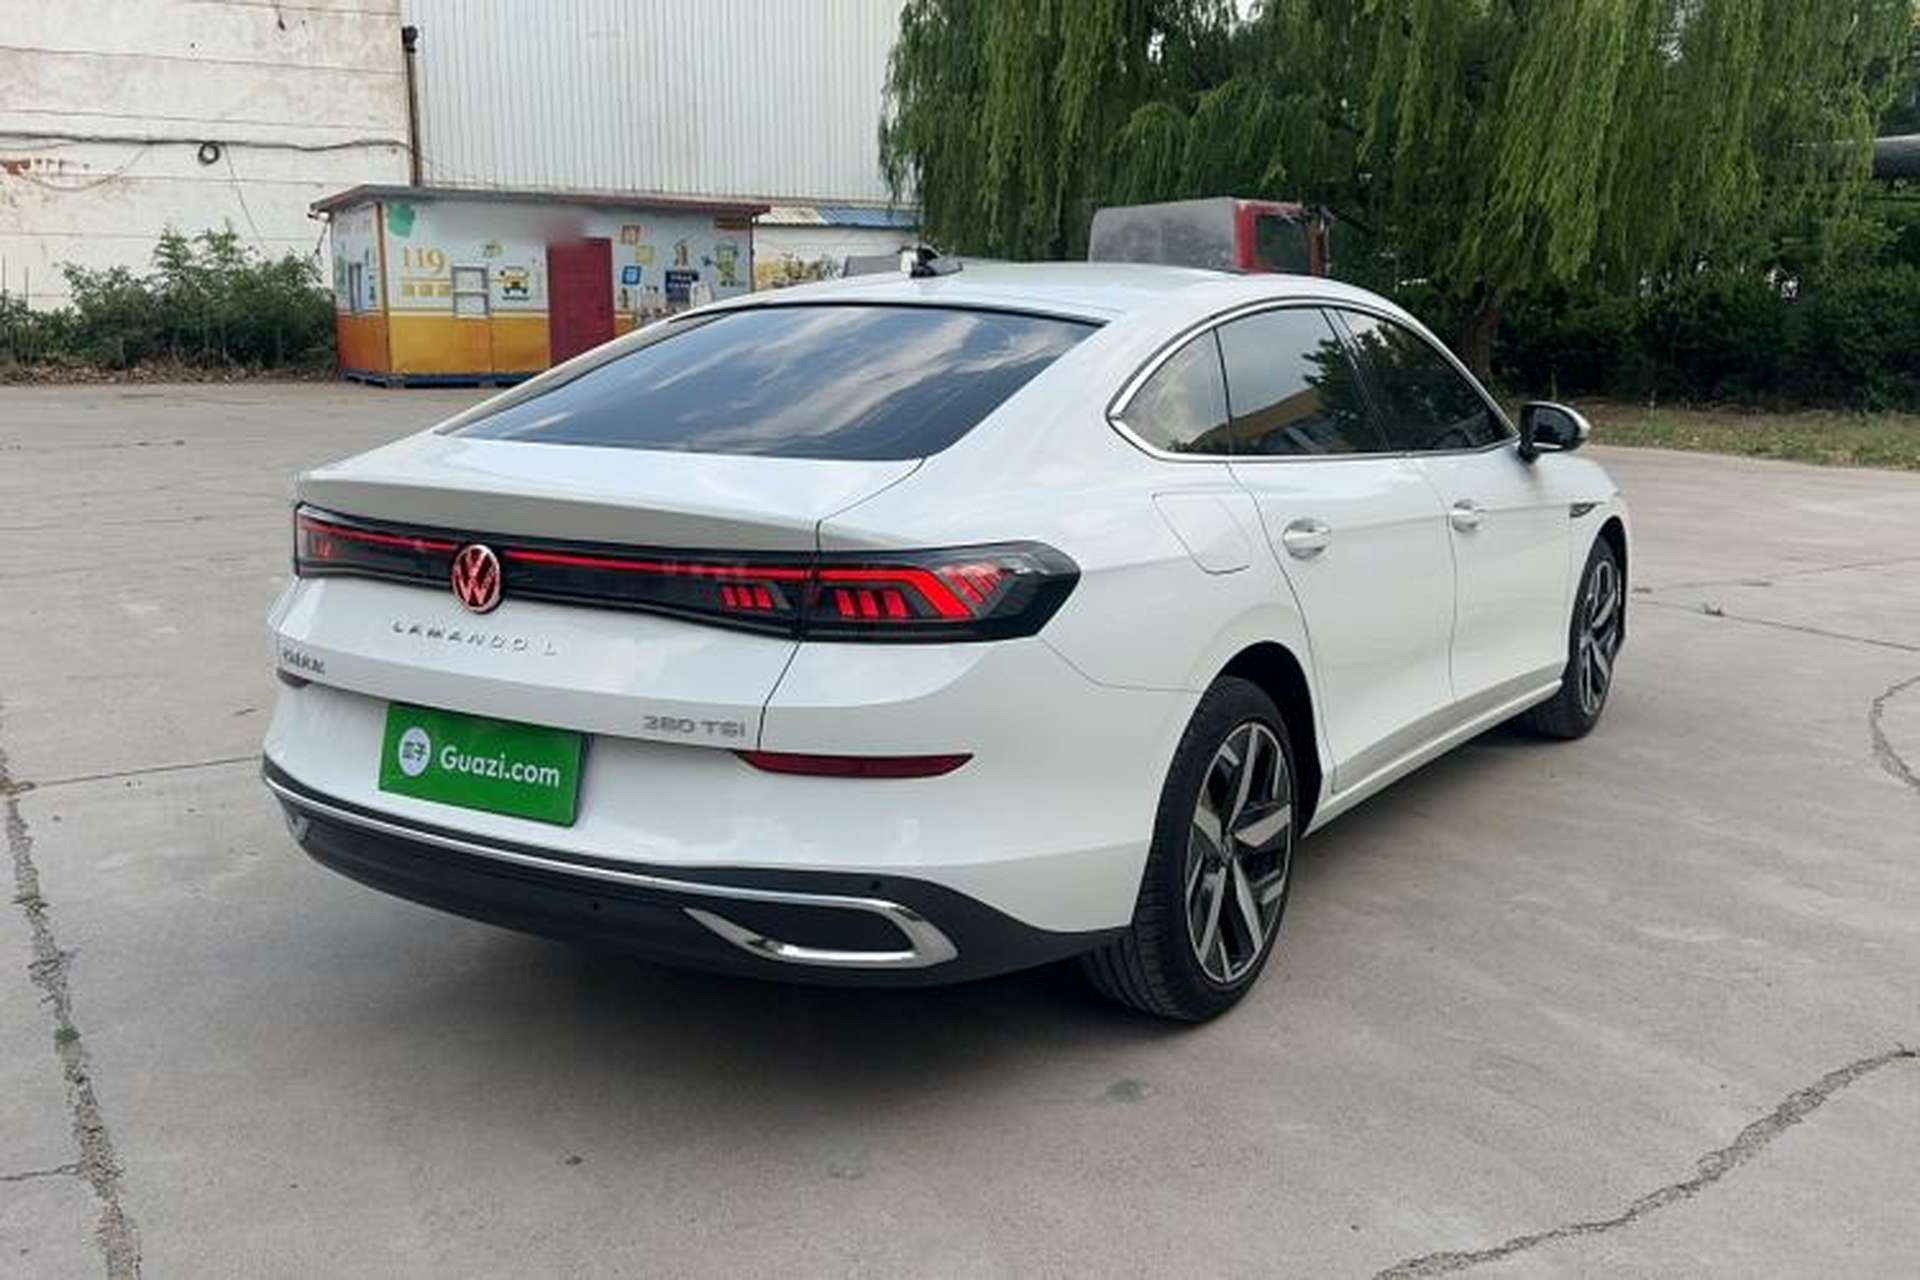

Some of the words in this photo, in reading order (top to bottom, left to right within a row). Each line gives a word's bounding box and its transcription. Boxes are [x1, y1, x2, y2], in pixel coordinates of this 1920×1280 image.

[403, 245, 446, 277] 119
[699, 720, 746, 738] TSI
[439, 744, 560, 789] Guazi.com
